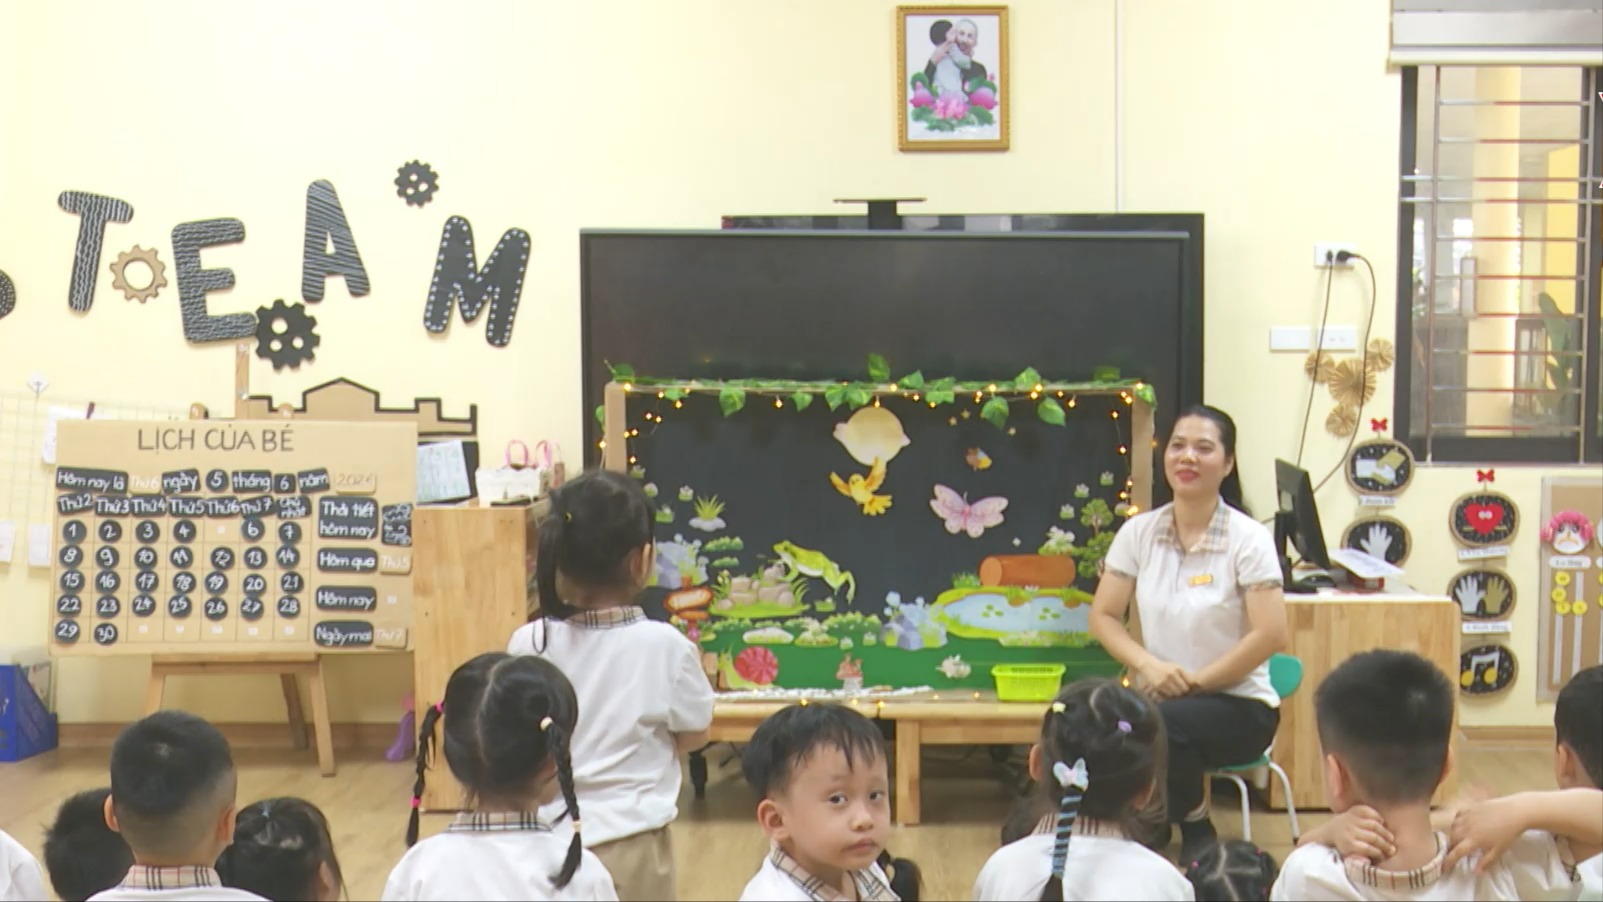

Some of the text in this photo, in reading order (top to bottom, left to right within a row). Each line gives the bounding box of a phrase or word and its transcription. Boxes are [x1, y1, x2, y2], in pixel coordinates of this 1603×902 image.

[0, 179, 532, 347] TEAM
[137, 424, 294, 455] LỊCH CỦA BÉ
[57, 471, 86, 487] Hôm
[87, 477, 111, 492] nay
[112, 476, 125, 491] là
[163, 471, 197, 493] ngày
[211, 471, 223, 488] 5
[232, 472, 271, 492] tháng
[280, 474, 290, 490] 6
[68, 521, 294, 540] 1 2 3 4 6 7
[319, 520, 376, 540] hôm nay
[63, 547, 296, 567] 8 9 10 11 12 13 14
[319, 551, 349, 567] Hôm
[64, 572, 299, 592] 15 16 17 18 19 20 21
[60, 597, 298, 615] 22 23 24 25 26 27 28
[317, 591, 375, 611] Hôm nay
[57, 622, 115, 642] 29 30
[316, 625, 348, 647] Ngày
